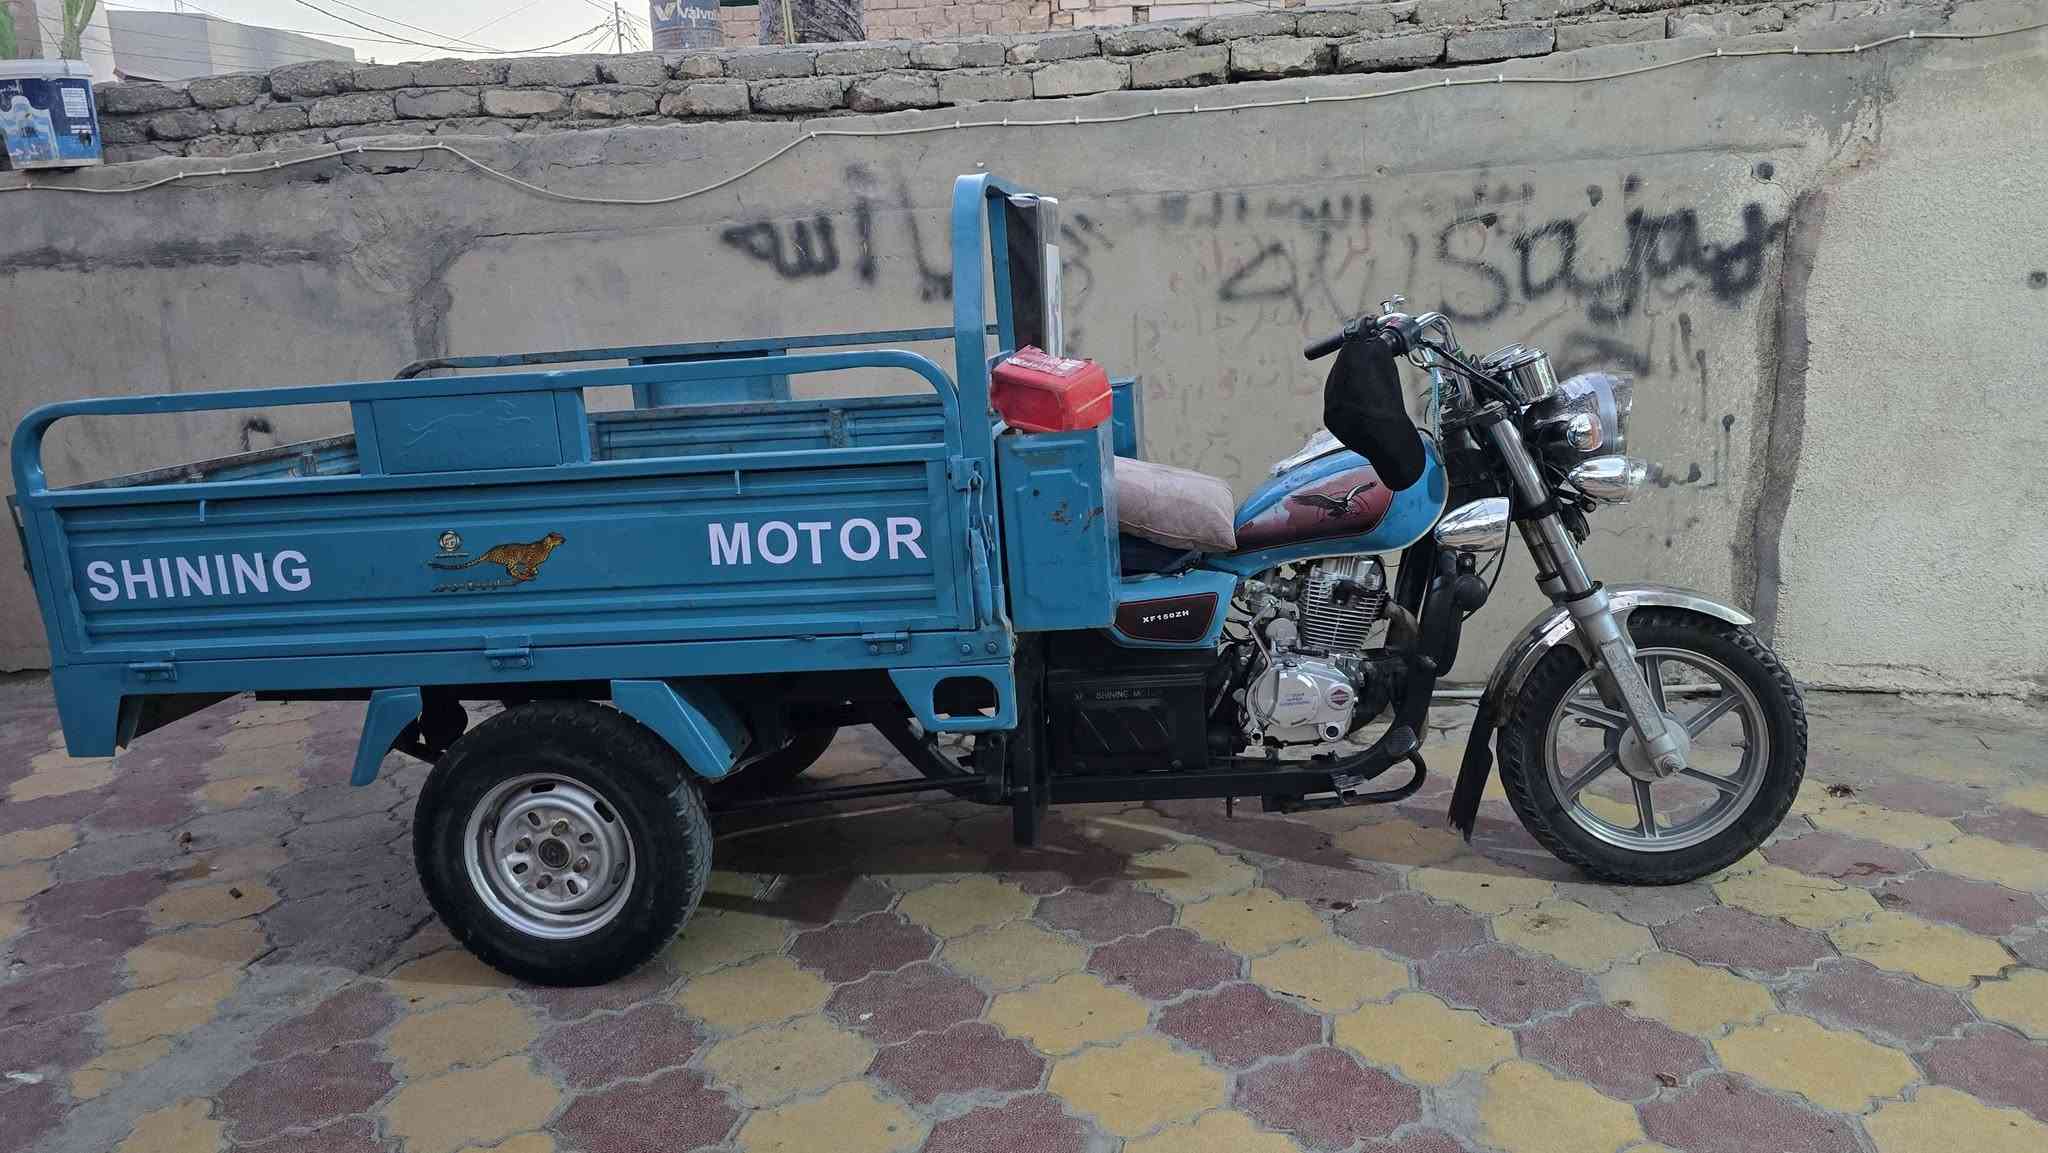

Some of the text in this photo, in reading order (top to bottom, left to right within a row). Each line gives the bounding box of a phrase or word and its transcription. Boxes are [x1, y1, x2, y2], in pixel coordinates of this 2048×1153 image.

[86, 516, 928, 601] SHINING MOTOR
[1142, 610, 1189, 623] XF150ZH
